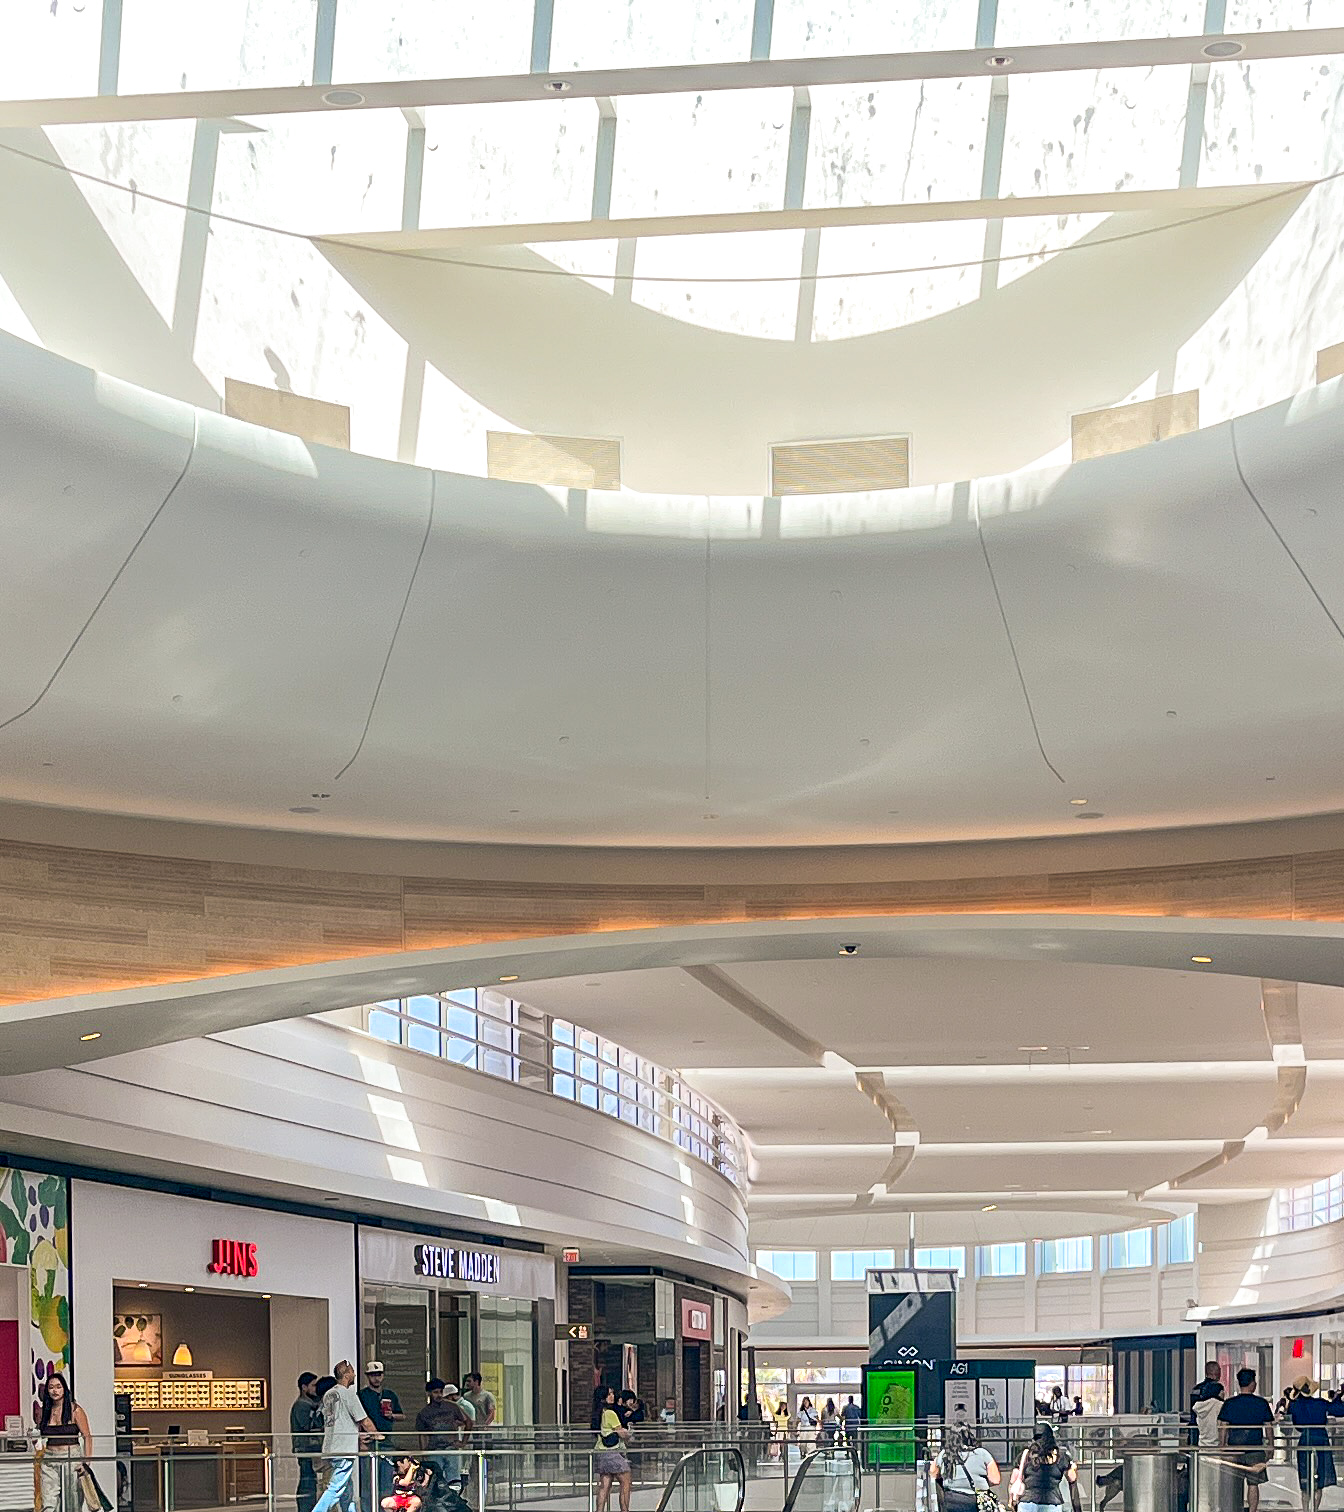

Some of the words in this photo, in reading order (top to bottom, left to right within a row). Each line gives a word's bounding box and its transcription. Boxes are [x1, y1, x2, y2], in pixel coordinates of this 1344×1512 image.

[207, 1238, 258, 1277] JINS
[414, 1244, 455, 1278] STEVE
[458, 1250, 500, 1284] MADDEN
[949, 1362, 968, 1374] AG1
[981, 1384, 996, 1396] The
